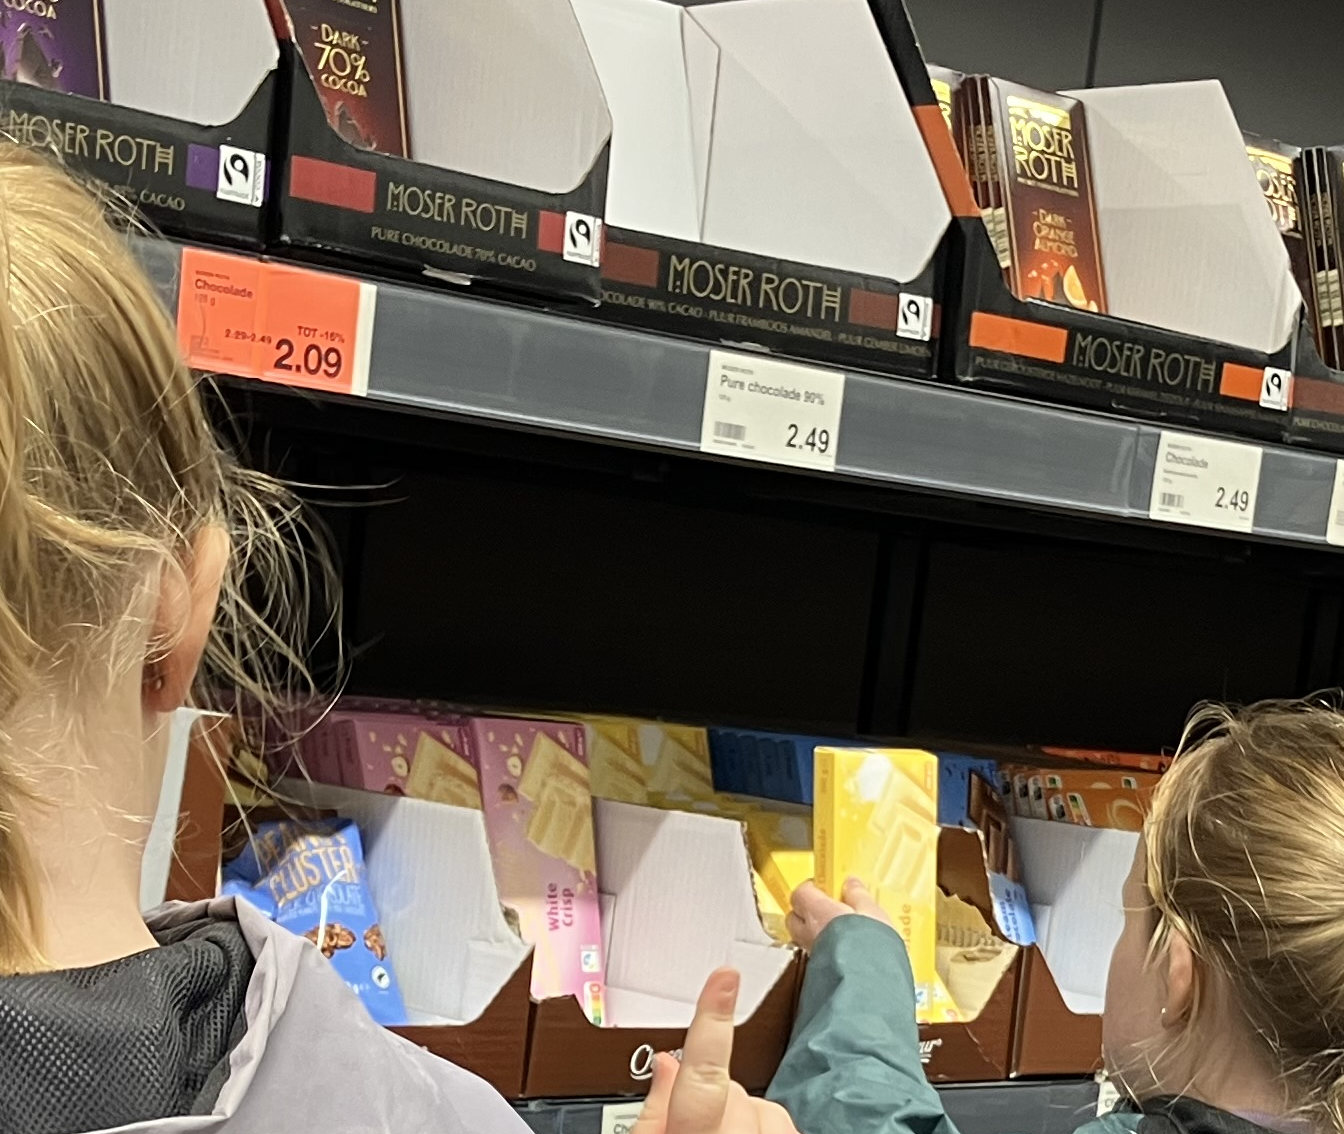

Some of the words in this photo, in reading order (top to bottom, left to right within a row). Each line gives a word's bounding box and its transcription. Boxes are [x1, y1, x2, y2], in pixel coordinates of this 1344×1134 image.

[320, 23, 361, 52] DARK
[314, 42, 370, 82] 70%
[320, 73, 368, 98] COCOA
[8, 109, 90, 158] MOSER
[96, 127, 175, 176] ROTH
[1009, 116, 1075, 160] MOSER
[1013, 145, 1079, 189] ROTH
[140, 189, 186, 212] CACAO
[386, 181, 456, 225] MOSER
[460, 197, 528, 240] ROTH
[370, 226, 401, 243] PURE
[497, 252, 537, 272] CACAO
[194, 278, 254, 300] Chocolade
[667, 254, 755, 307] MOSER
[758, 272, 842, 322] ROTH
[273, 338, 342, 379] 2.09
[1072, 331, 1143, 379] MOSER
[1146, 348, 1217, 394] ROTH
[720, 373, 745, 391] Pure
[785, 422, 830, 453] 2.49
[1214, 486, 1249, 512] 2.49
[547, 883, 560, 932] White
[562, 888, 575, 927] Crisp
